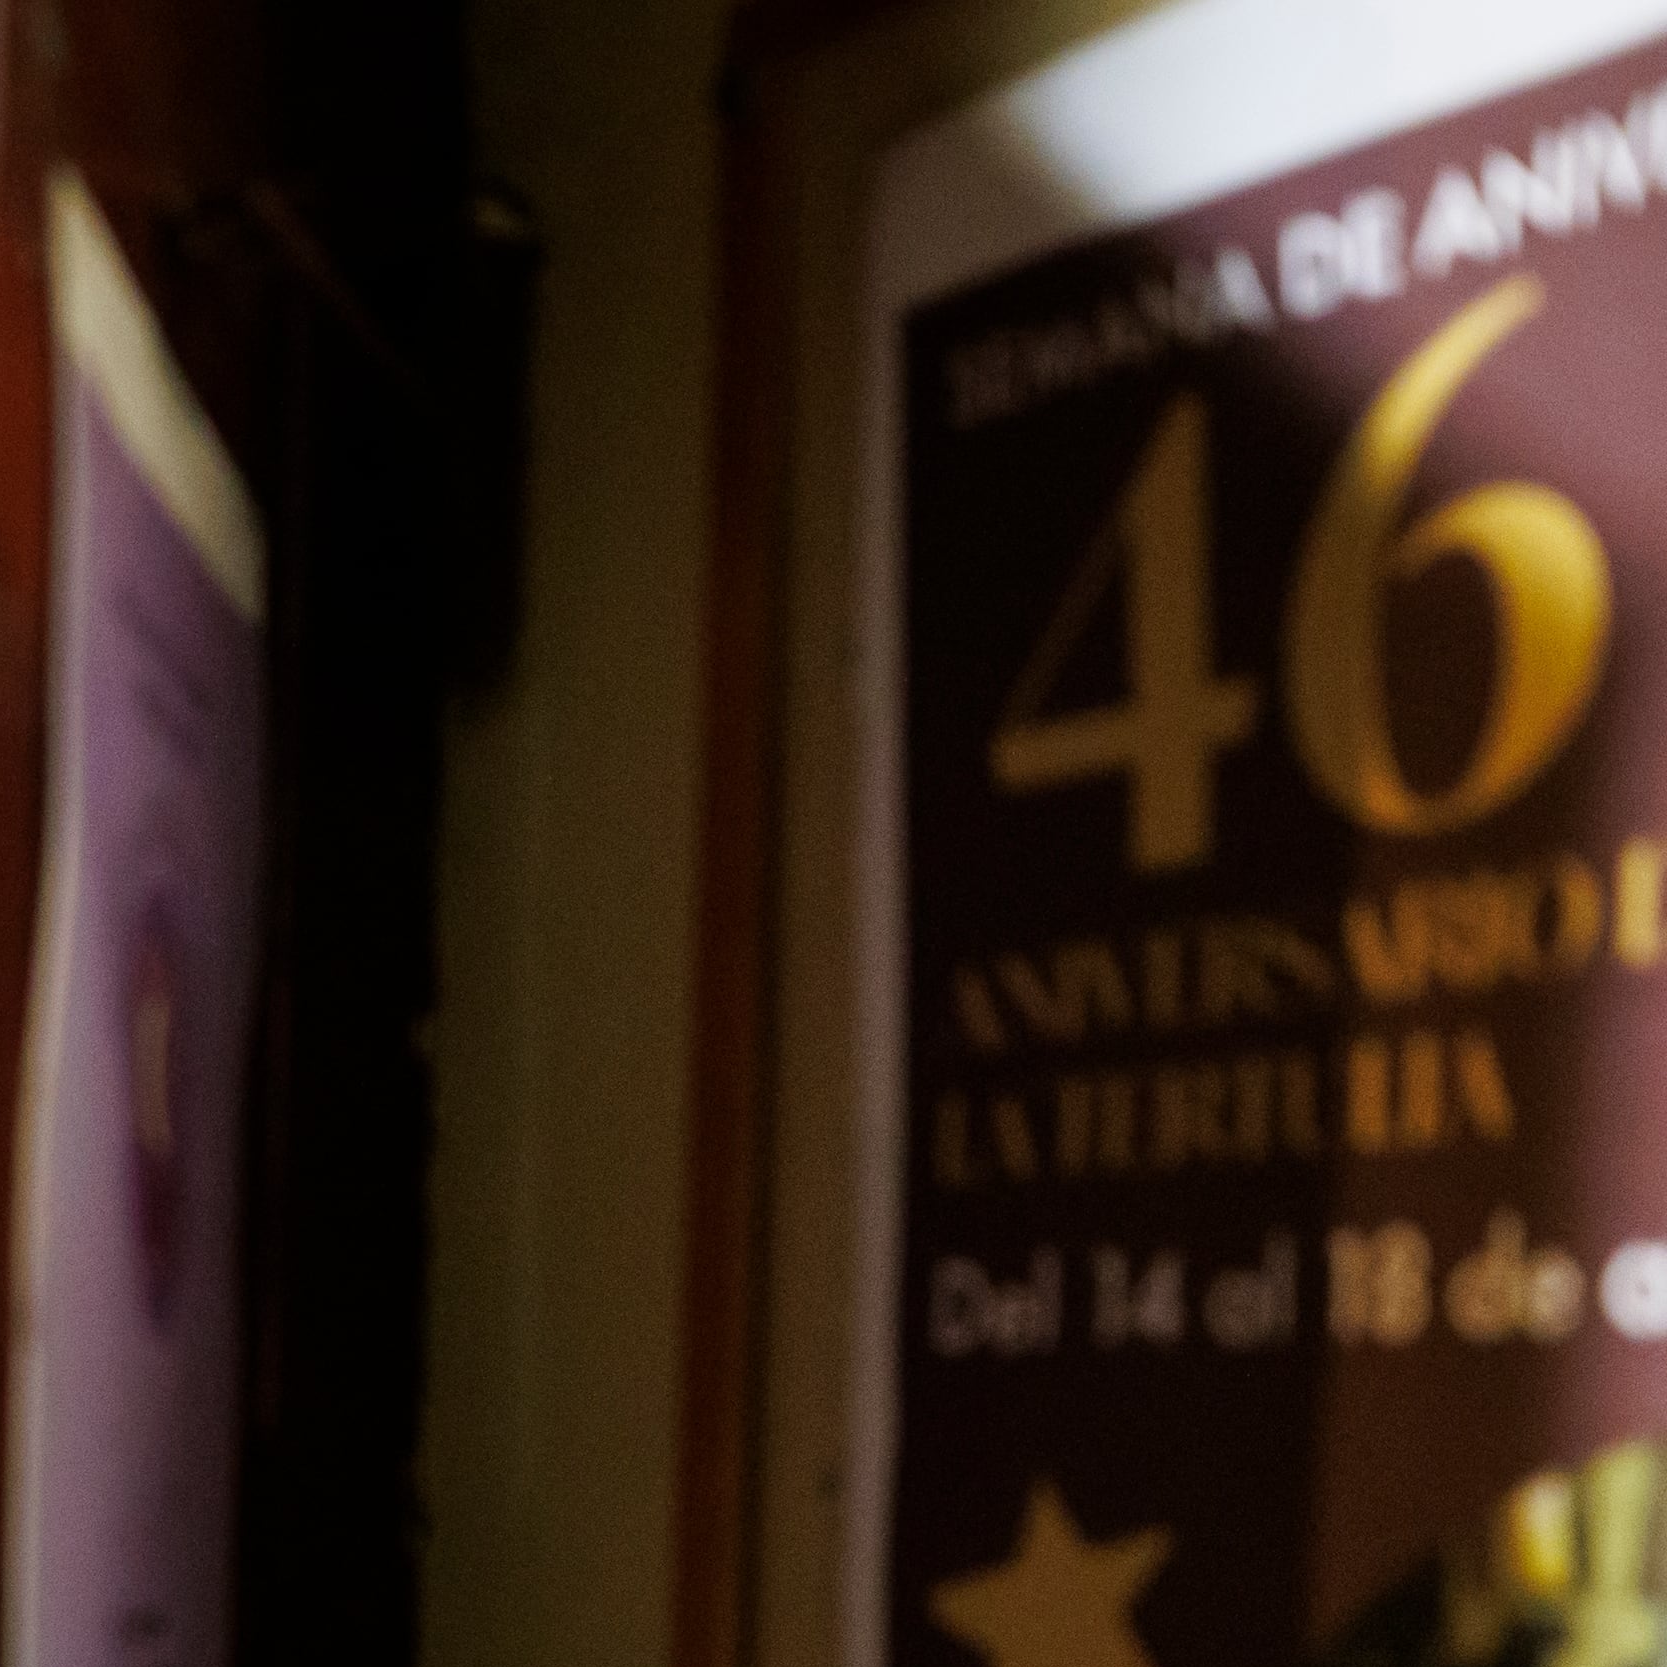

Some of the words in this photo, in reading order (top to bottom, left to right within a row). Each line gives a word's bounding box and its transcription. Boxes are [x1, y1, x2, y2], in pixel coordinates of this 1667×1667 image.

[1276, 185, 1410, 320] DE
[1411, 82, 1667, 282] ANIV
[987, 270, 1613, 872] 46
[927, 1242, 1065, 1363] Del
[1091, 1243, 1189, 1354] 14
[1202, 1225, 1301, 1356] al
[1325, 1217, 1436, 1352] 18
[1444, 1206, 1589, 1351] de
